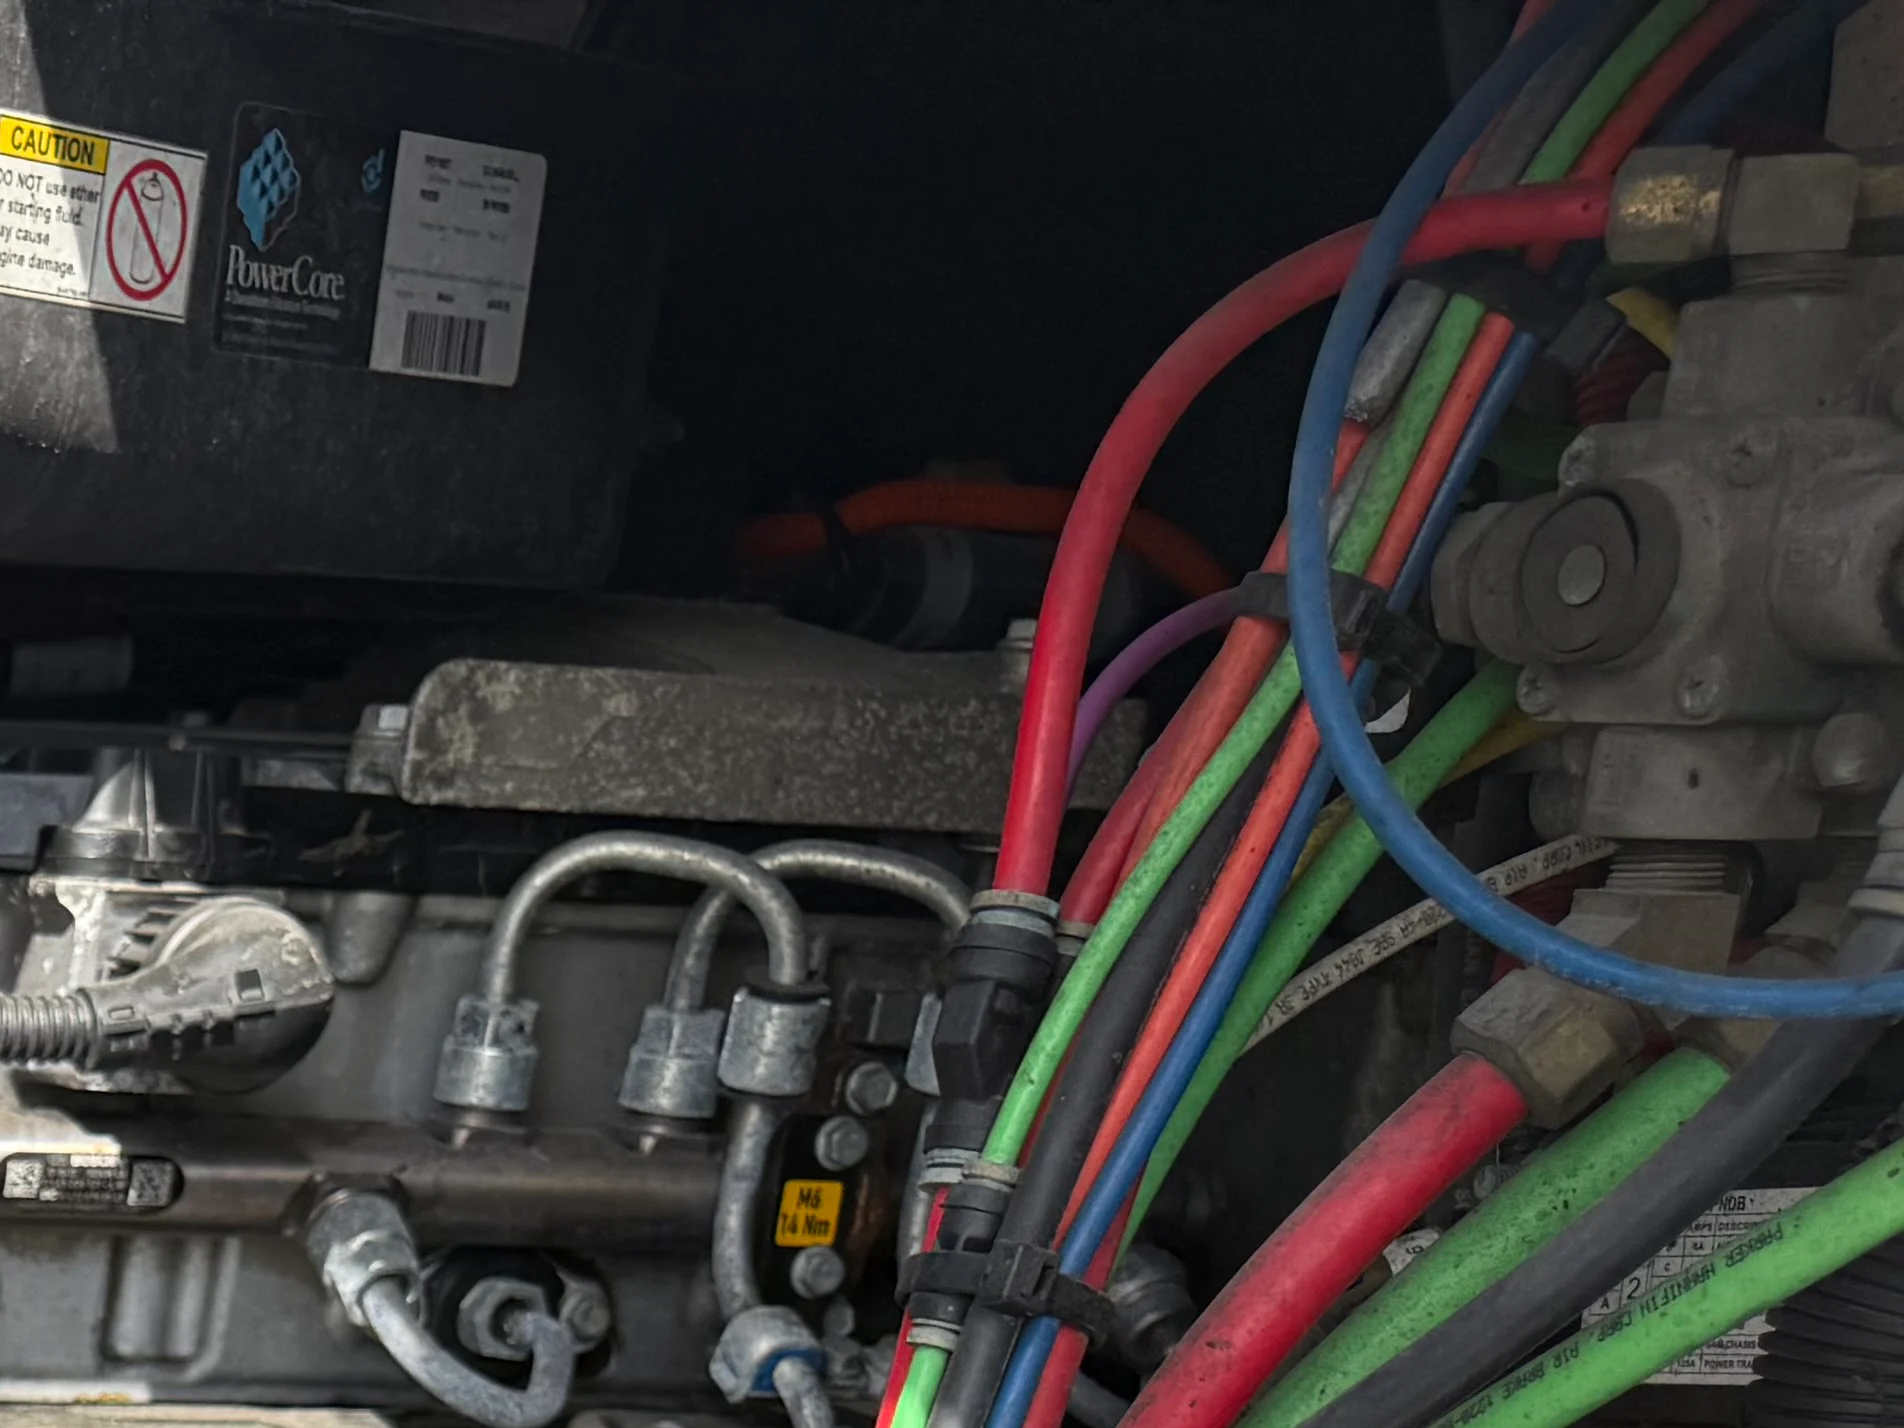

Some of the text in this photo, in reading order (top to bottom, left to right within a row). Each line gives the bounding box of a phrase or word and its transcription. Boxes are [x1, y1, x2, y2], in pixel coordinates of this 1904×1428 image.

[11, 126, 95, 166] CAUTION
[17, 172, 43, 193] NOT
[46, 181, 67, 197] use
[69, 184, 101, 204] ether
[8, 200, 51, 224] starting
[55, 204, 84, 226] fluid.
[15, 228, 50, 245] cause
[28, 253, 76, 278] damage.
[225, 244, 345, 300] PowerCore
[797, 1187, 823, 1209] M6
[781, 1213, 831, 1236] 14 Nm
[1626, 1277, 1641, 1300] 2
